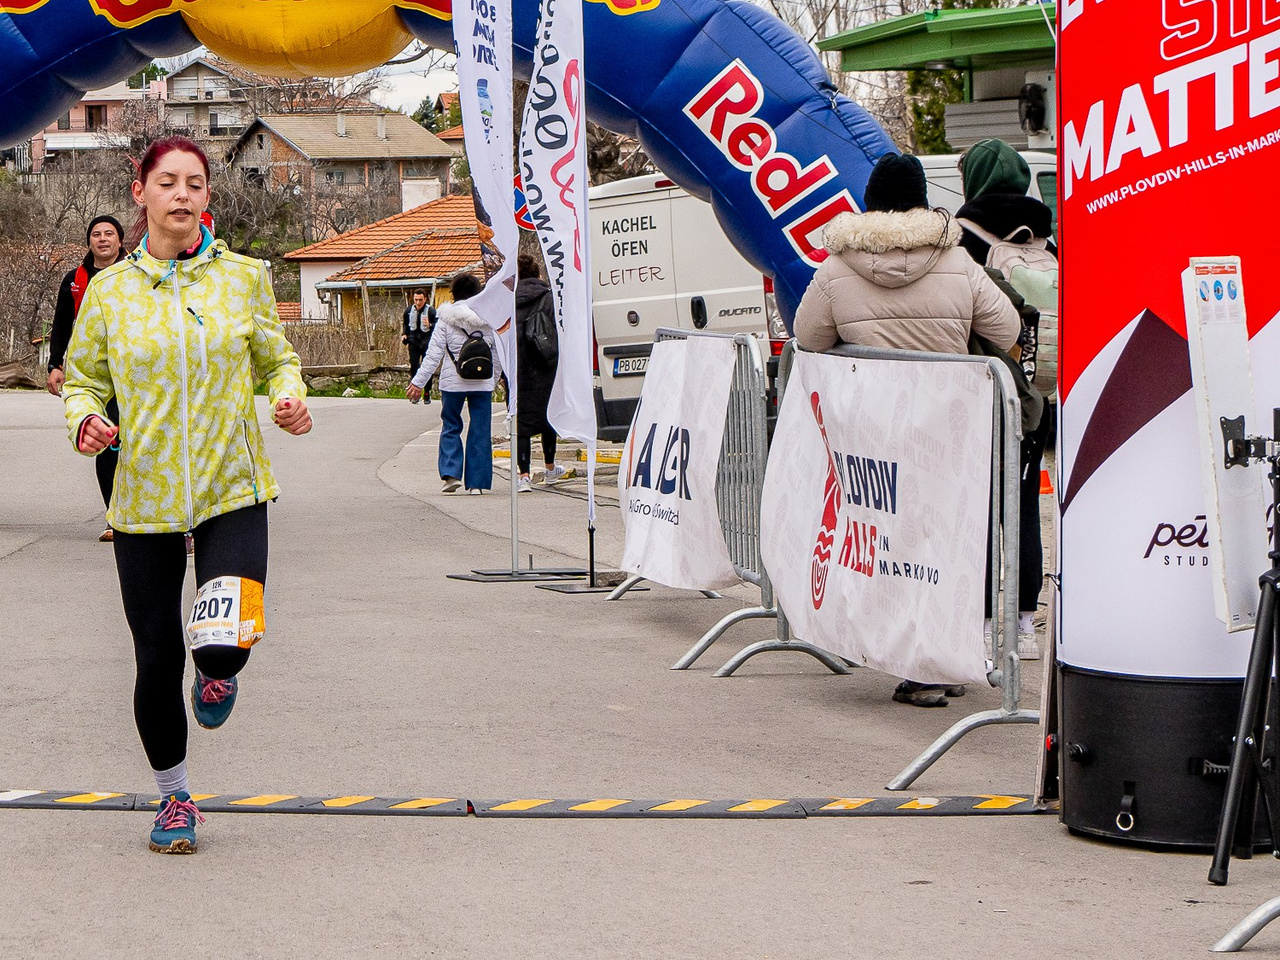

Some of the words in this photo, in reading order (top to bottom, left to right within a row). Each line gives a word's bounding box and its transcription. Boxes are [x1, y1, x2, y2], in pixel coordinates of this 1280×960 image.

[1064, 30, 1280, 201] MATTE
[688, 64, 833, 213] Red
[601, 215, 657, 236] KACHEL
[611, 238, 649, 258] ÖFEN
[598, 266, 665, 287] LEITER
[718, 306, 762, 317] DUCATO
[620, 360, 630, 372] PB
[631, 358, 650, 371] 027
[879, 534, 890, 552] IN
[879, 560, 939, 585] MARKOVO
[192, 597, 233, 624] 1207
